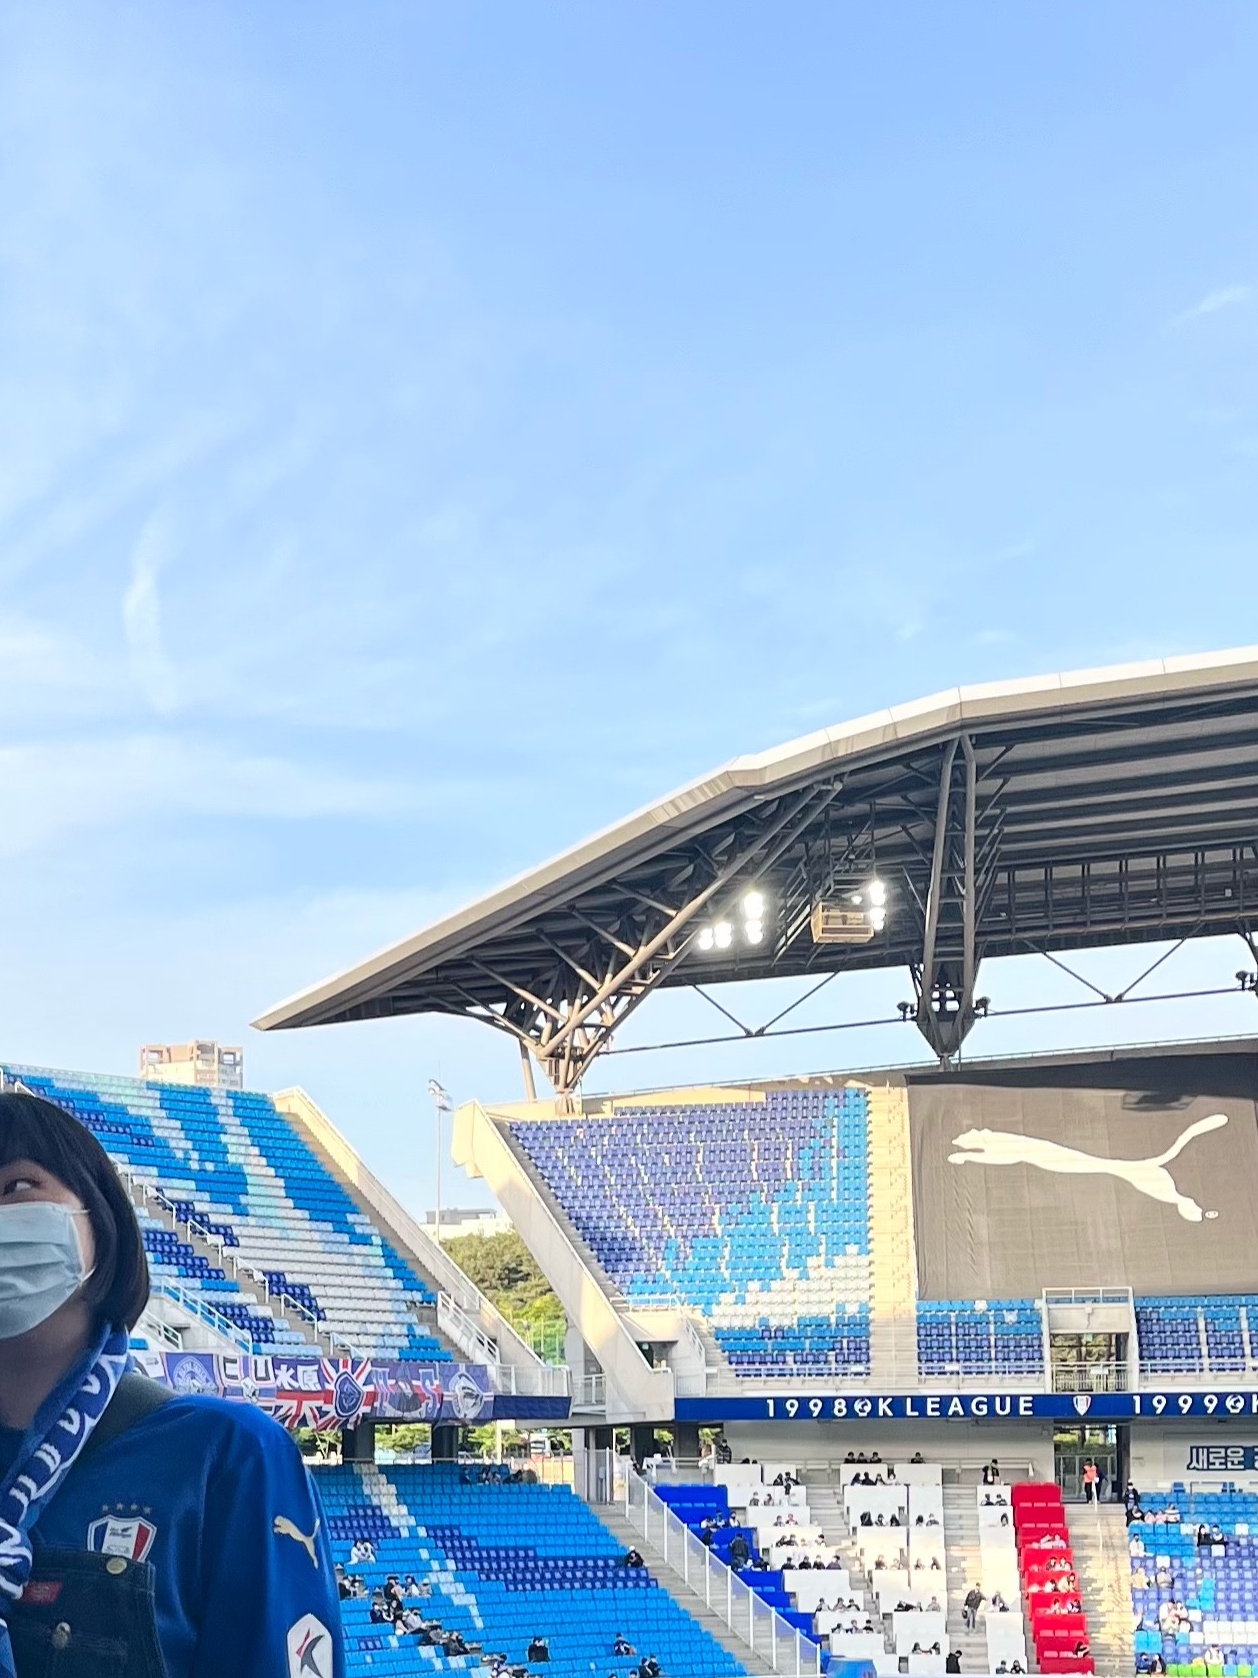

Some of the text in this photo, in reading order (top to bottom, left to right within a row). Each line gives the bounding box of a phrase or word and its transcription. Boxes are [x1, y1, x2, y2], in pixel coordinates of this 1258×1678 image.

[766, 1395, 1035, 1418] 1998 K LEAGUE
[1132, 1393, 1218, 1416] 1999
[1188, 1446, 1245, 1470] 새로운
